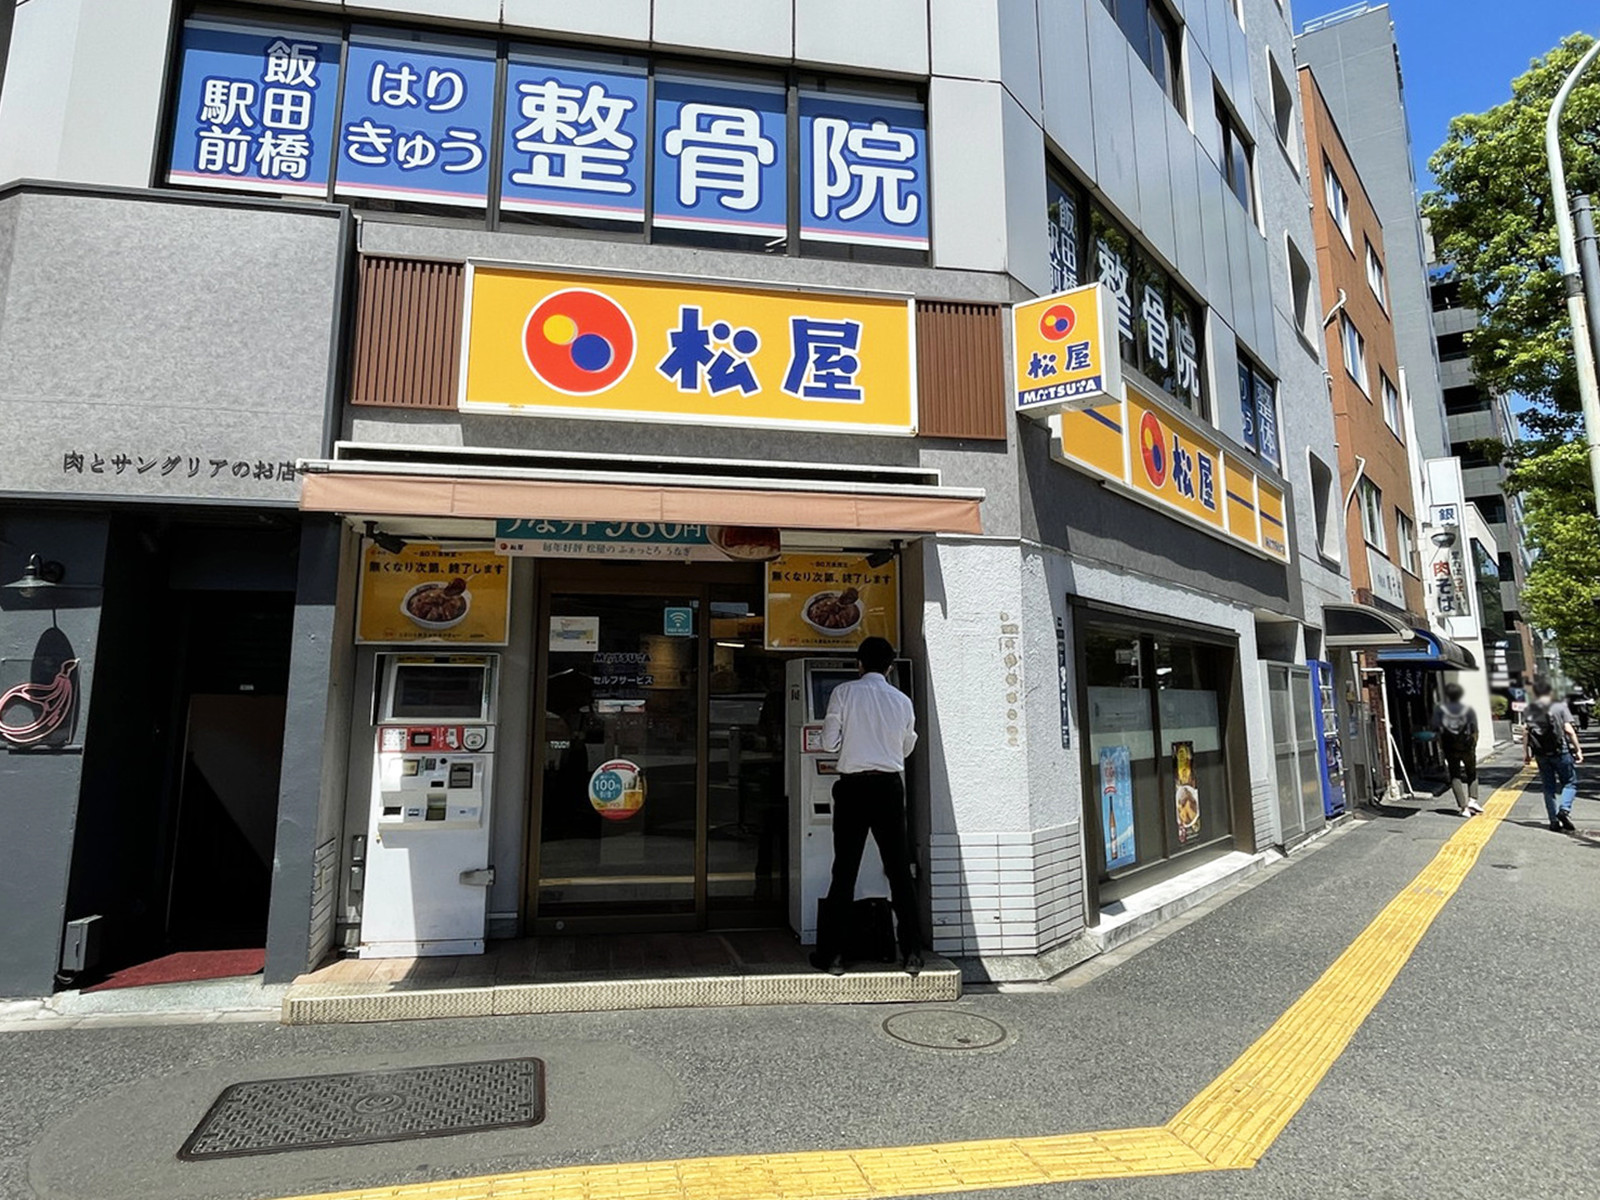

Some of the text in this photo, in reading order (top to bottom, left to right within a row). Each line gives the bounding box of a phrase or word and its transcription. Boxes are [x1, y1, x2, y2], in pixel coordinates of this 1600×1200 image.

[256, 40, 318, 179] 飯田橋
[371, 63, 465, 111] はり
[199, 80, 255, 173] 駅前
[346, 124, 484, 173] きゅう
[512, 79, 919, 225] 整骨院
[657, 306, 863, 401] 松屋
[1028, 341, 1091, 378] 松屋
[1023, 379, 1097, 403] MATSUYA
[63, 450, 297, 481] 肉とサングリアのお店
[1172, 433, 1216, 511] 松屋
[1438, 507, 1457, 527] 銀
[1433, 561, 1455, 613] 肉そば
[594, 675, 653, 685] セルフサービス
